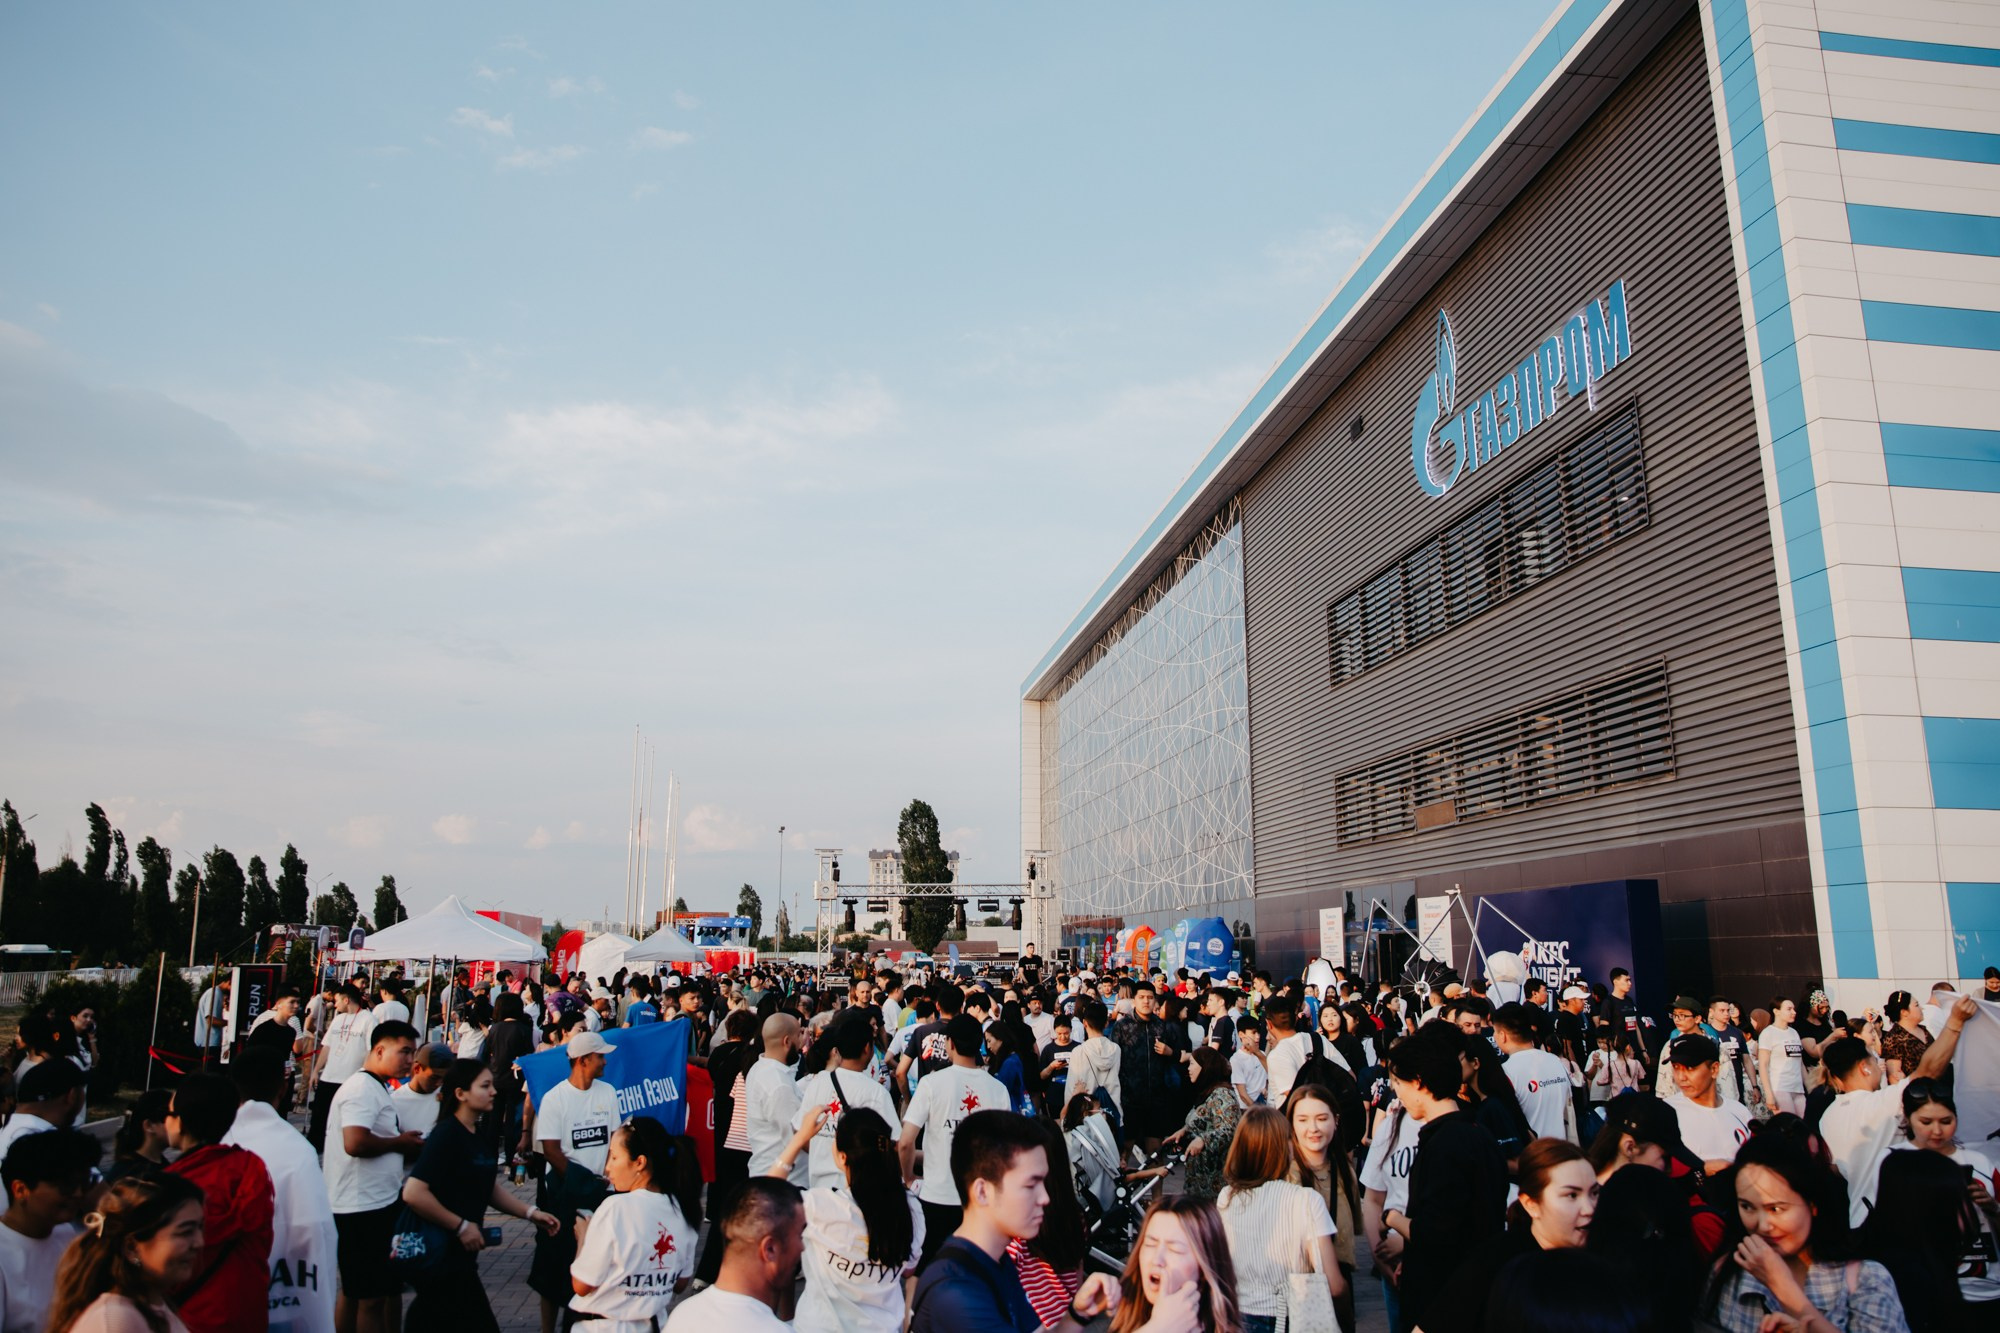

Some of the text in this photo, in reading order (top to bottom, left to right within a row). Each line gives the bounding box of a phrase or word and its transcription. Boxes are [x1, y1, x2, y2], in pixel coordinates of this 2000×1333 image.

[1464, 278, 1632, 473] ГАЗПРОМ
[250, 984, 262, 1017] RUN
[932, 1048, 950, 1060] RU
[616, 1085, 646, 1115] анк
[573, 1127, 602, 1140] 6804
[268, 1257, 318, 1292] АН
[268, 1296, 301, 1310] УСА
